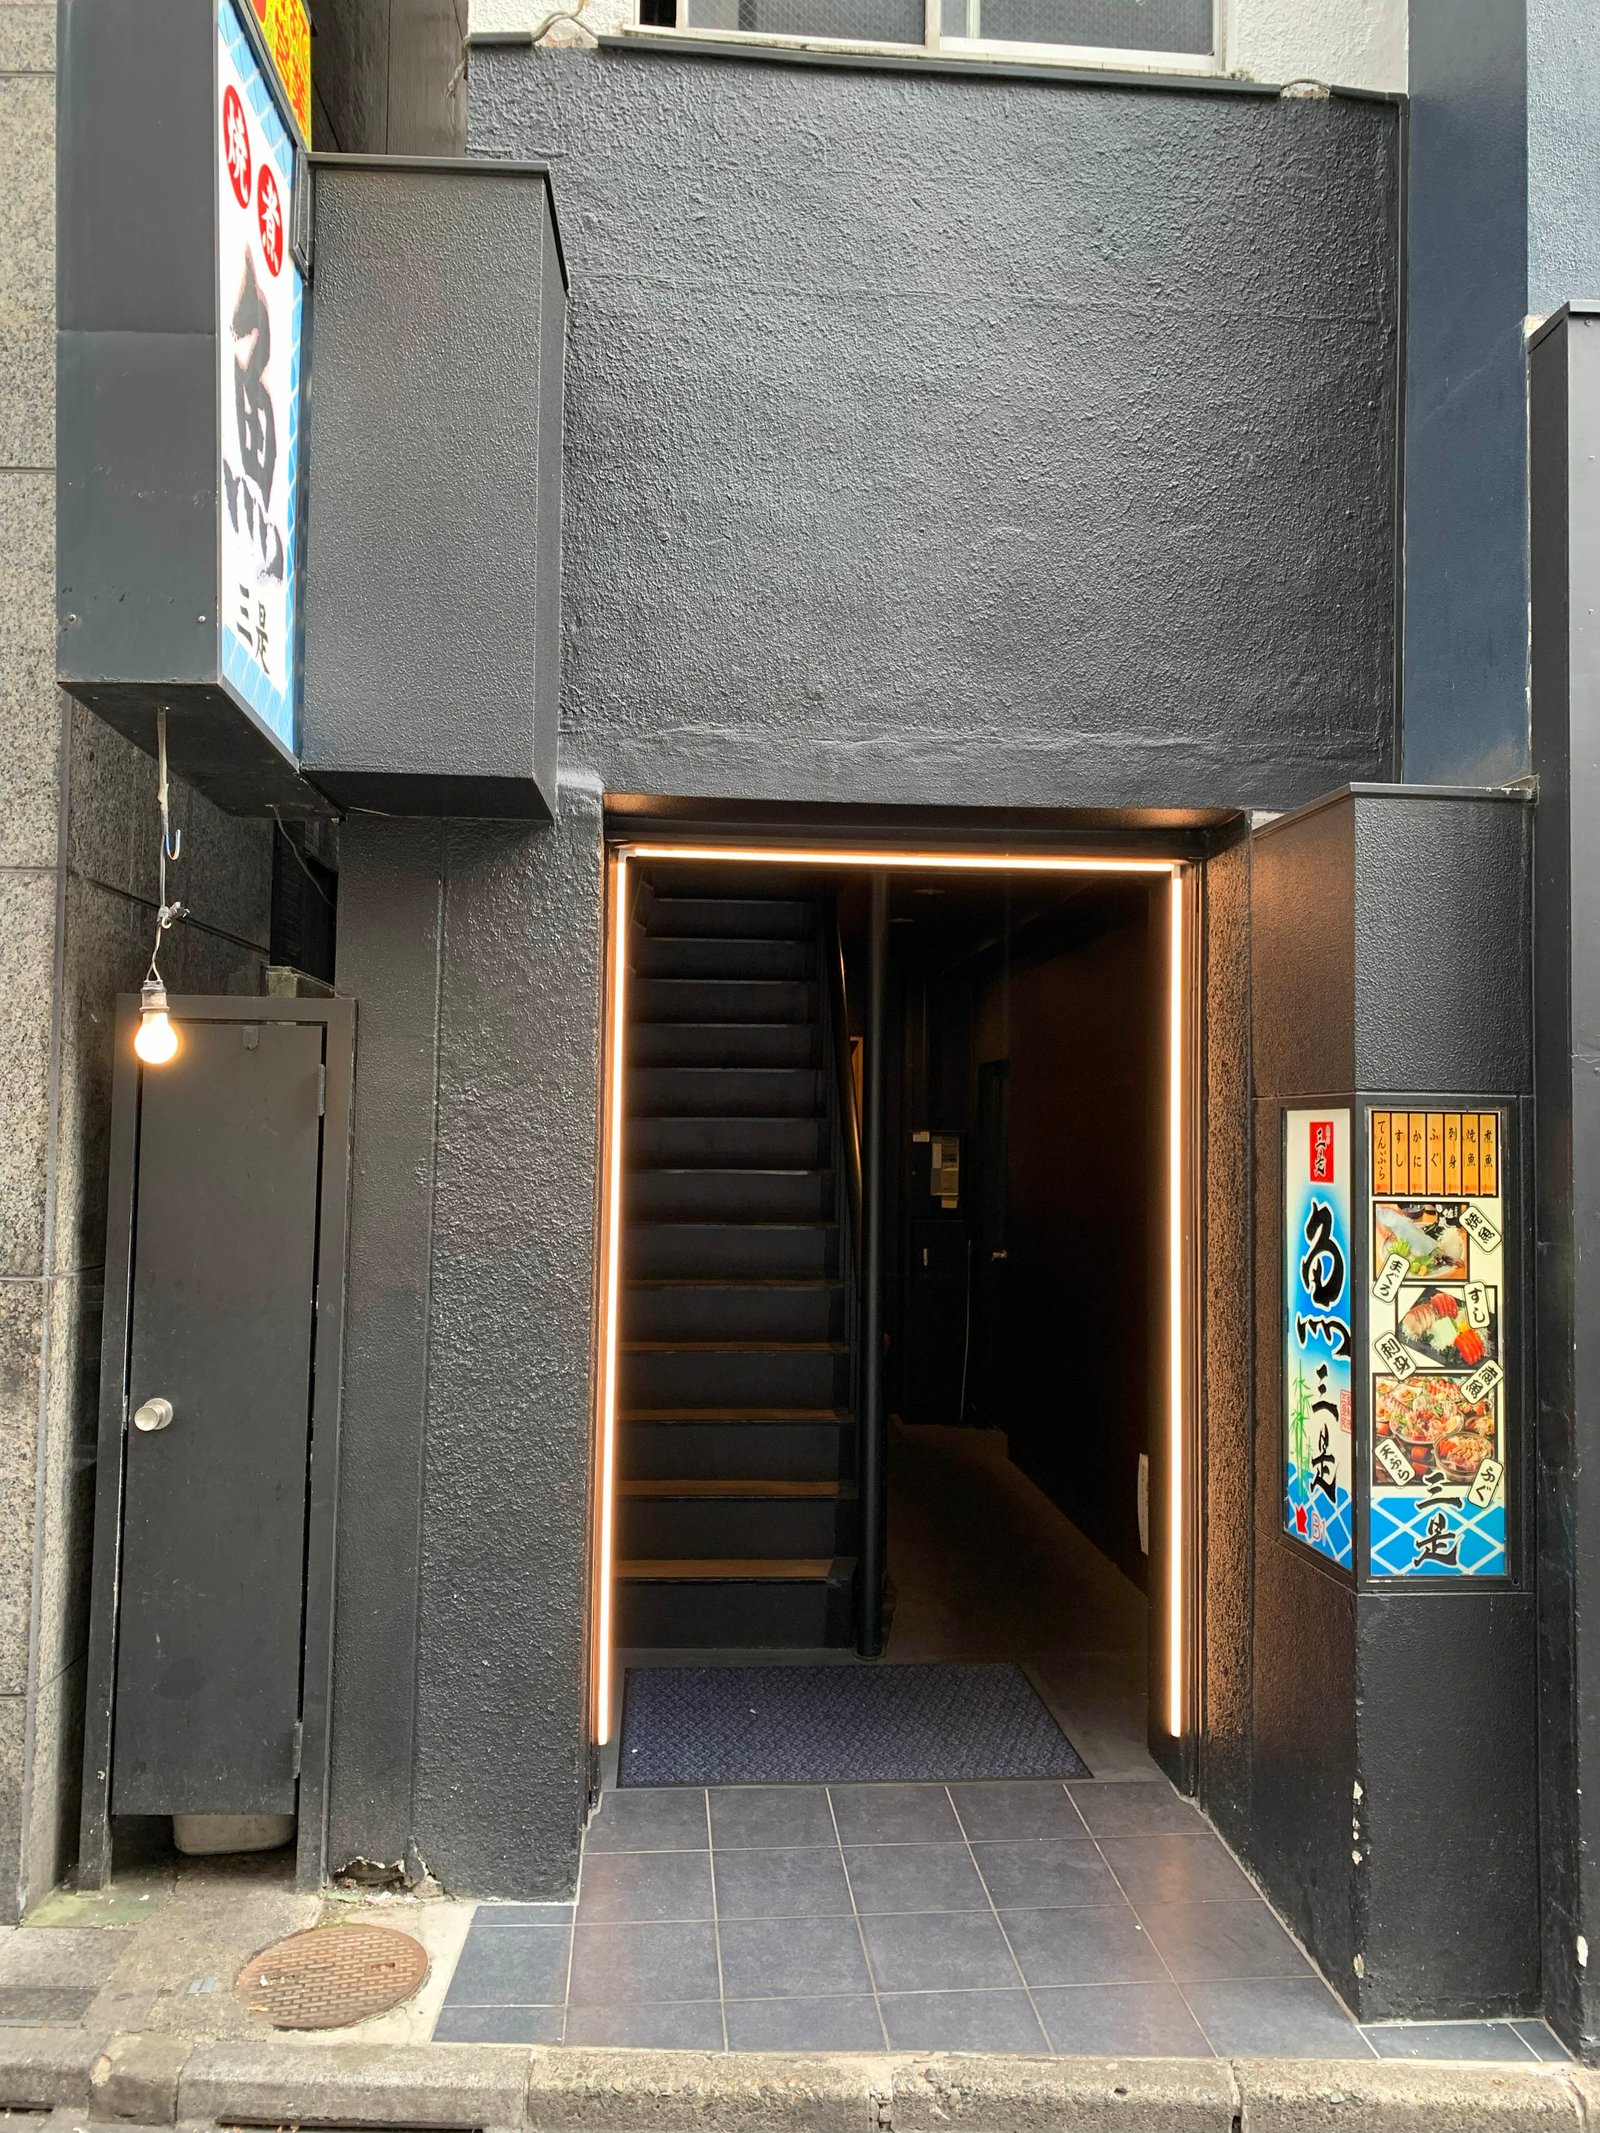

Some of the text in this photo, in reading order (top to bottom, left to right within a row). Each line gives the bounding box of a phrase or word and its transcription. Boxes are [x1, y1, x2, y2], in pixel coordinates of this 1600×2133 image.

[1378, 1120, 1387, 1180] てんぷら
[1395, 1129, 1404, 1168] すし
[1412, 1129, 1423, 1168] かに
[1429, 1128, 1440, 1168] ふぐ
[1448, 1127, 1458, 1169] 刺身
[1466, 1128, 1477, 1168] 焼魚
[1484, 1129, 1494, 1169] 煮魚
[1464, 1212, 1496, 1245] 焼魚
[1380, 1259, 1404, 1298] まぐろ
[1468, 1287, 1486, 1324] すし
[1380, 1337, 1411, 1376] 刺身
[1379, 1443, 1411, 1482] 天ぷら
[1475, 1466, 1497, 1503] ふぐ
[1312, 1512, 1327, 1548] B1
